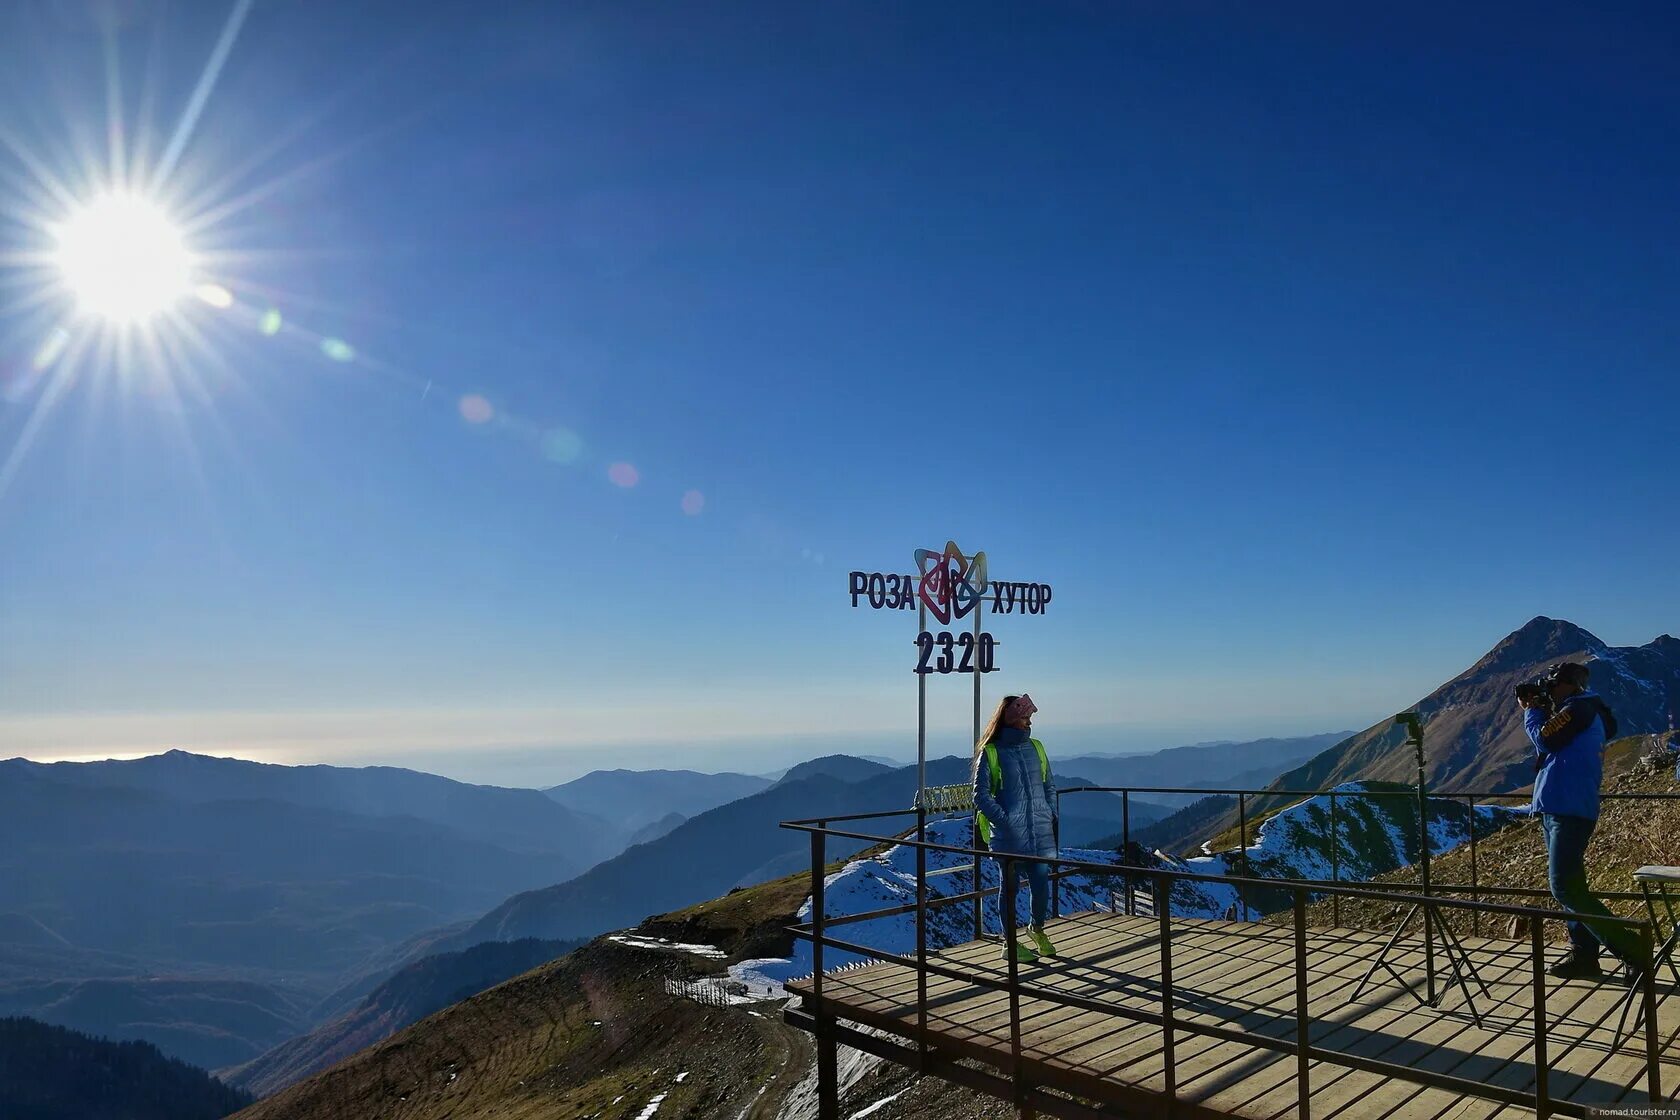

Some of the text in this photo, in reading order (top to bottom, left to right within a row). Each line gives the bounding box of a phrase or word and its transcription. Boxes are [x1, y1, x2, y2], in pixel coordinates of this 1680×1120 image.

[850, 571, 1052, 614] РОЗА ХУТОР
[916, 631, 994, 674] 2320
